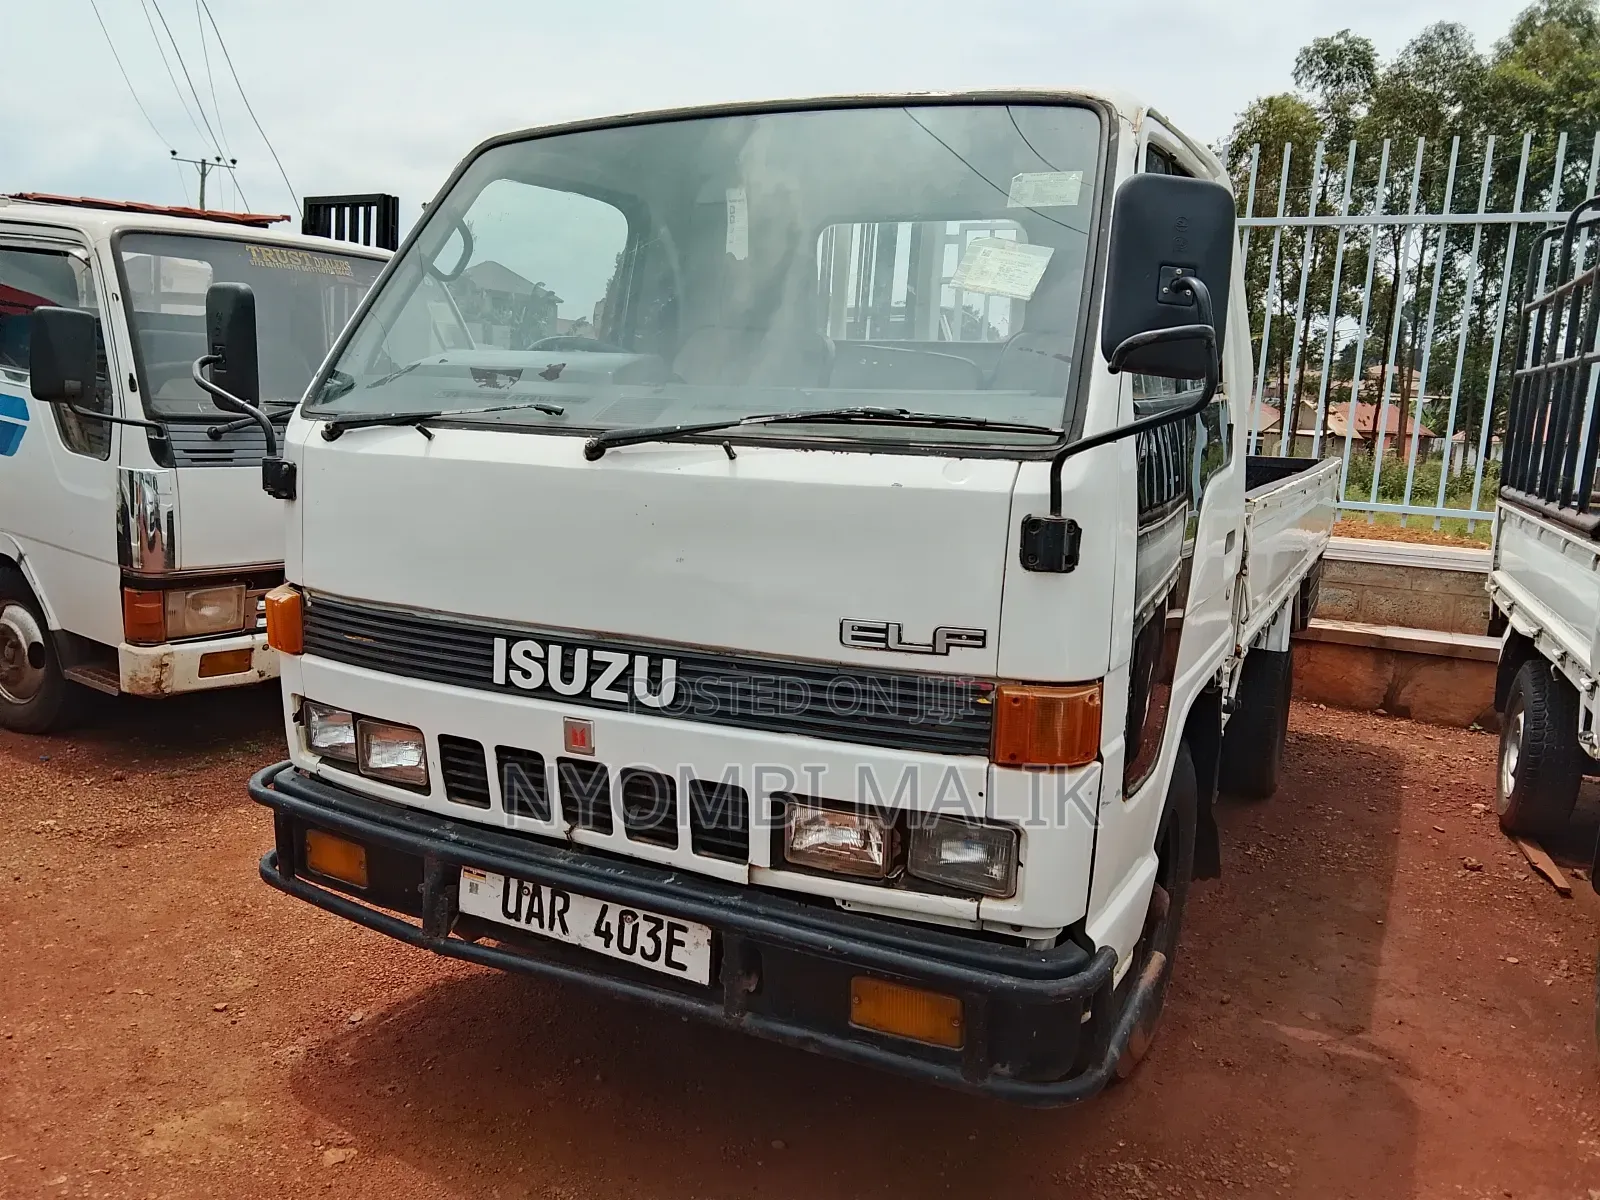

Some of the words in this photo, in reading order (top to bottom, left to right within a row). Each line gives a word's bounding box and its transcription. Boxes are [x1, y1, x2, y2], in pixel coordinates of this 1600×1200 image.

[246, 245, 312, 267] TRUST
[313, 257, 351, 271] DEALERS
[839, 617, 987, 655] ELF
[493, 637, 678, 708] ISUZU
[502, 876, 570, 935] UAR
[593, 904, 689, 972] 403E
